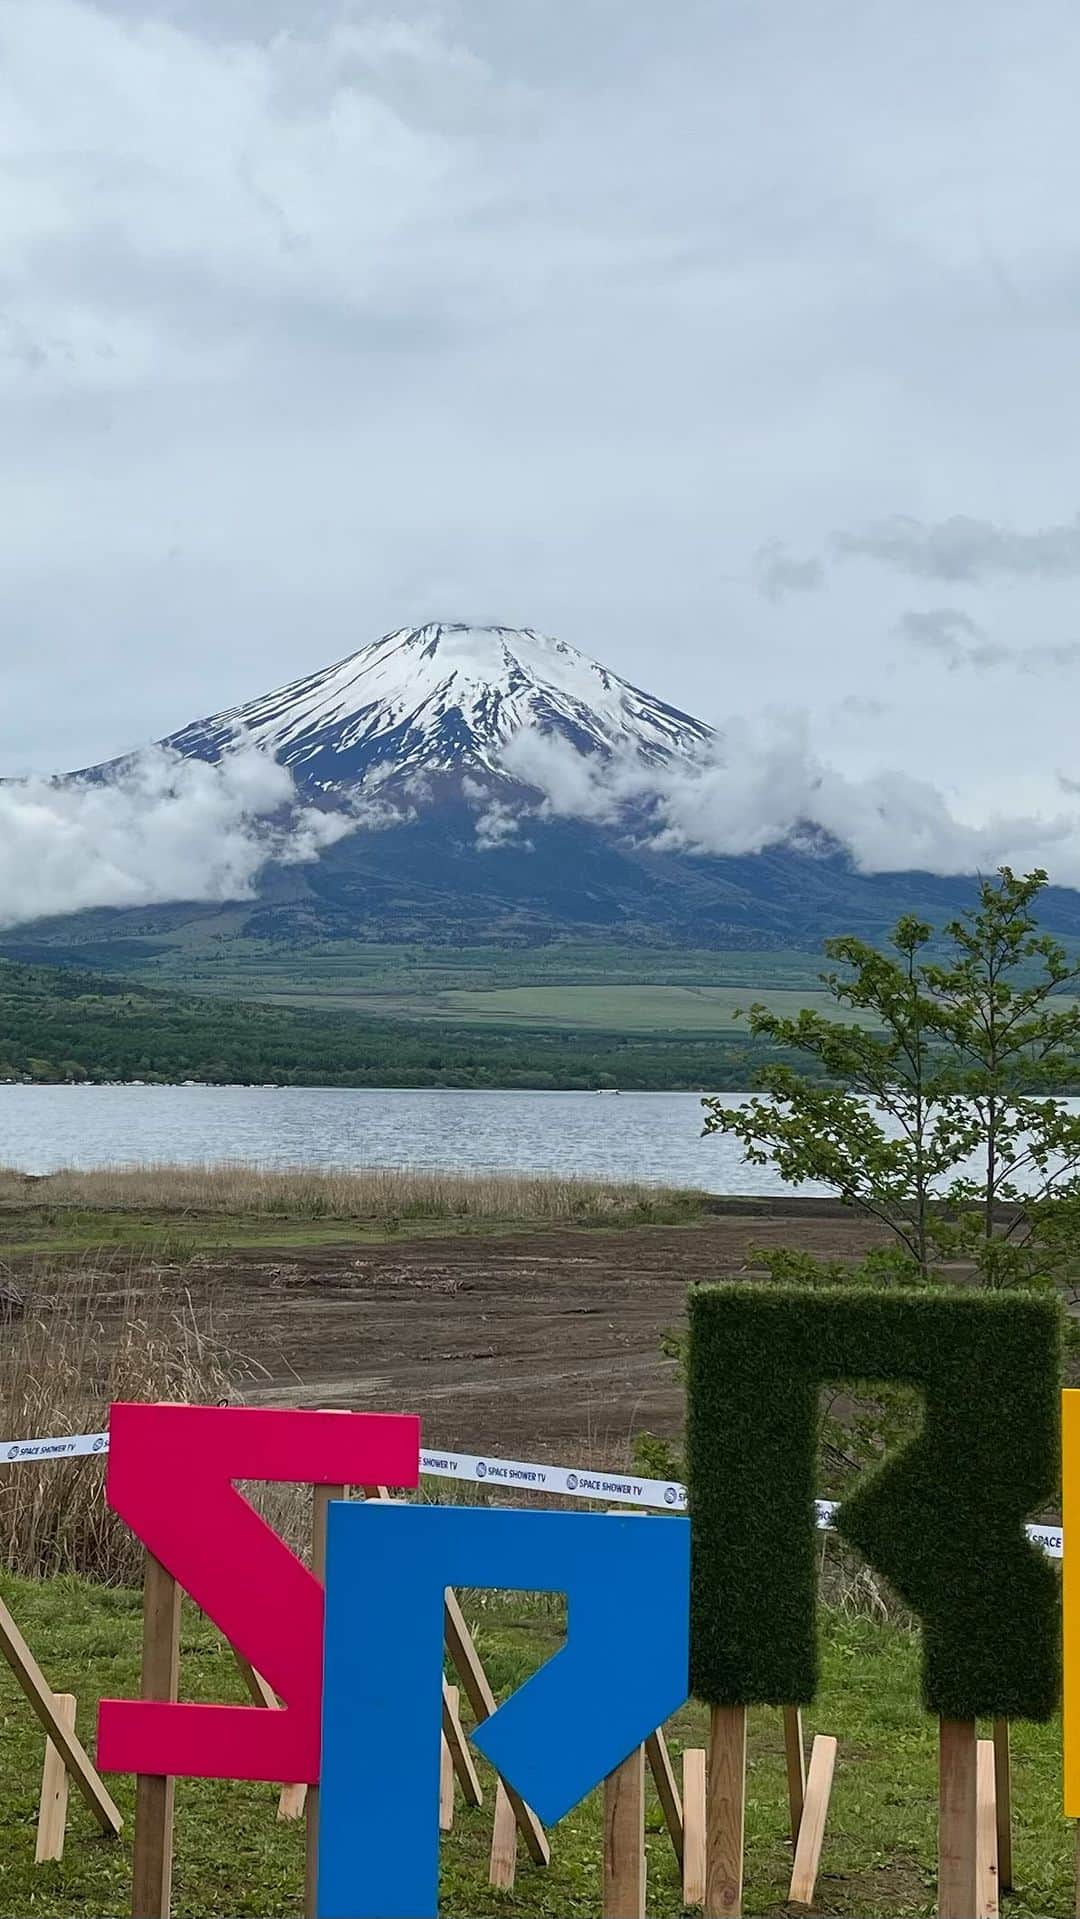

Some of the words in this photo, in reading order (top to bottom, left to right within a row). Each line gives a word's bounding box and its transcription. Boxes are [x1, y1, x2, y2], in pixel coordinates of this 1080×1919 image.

[20, 1446, 39, 1456] SPACE
[67, 1443, 76, 1452] TV
[423, 1457, 449, 1469] SHOWER
[449, 1461, 458, 1471] TV
[488, 1466, 507, 1477] SPACE
[509, 1469, 536, 1481] SHOWER
[537, 1473, 546, 1483] TV
[579, 1478, 601, 1490] SPACE
[602, 1482, 631, 1494] SHOWER
[633, 1485, 643, 1496] TV
